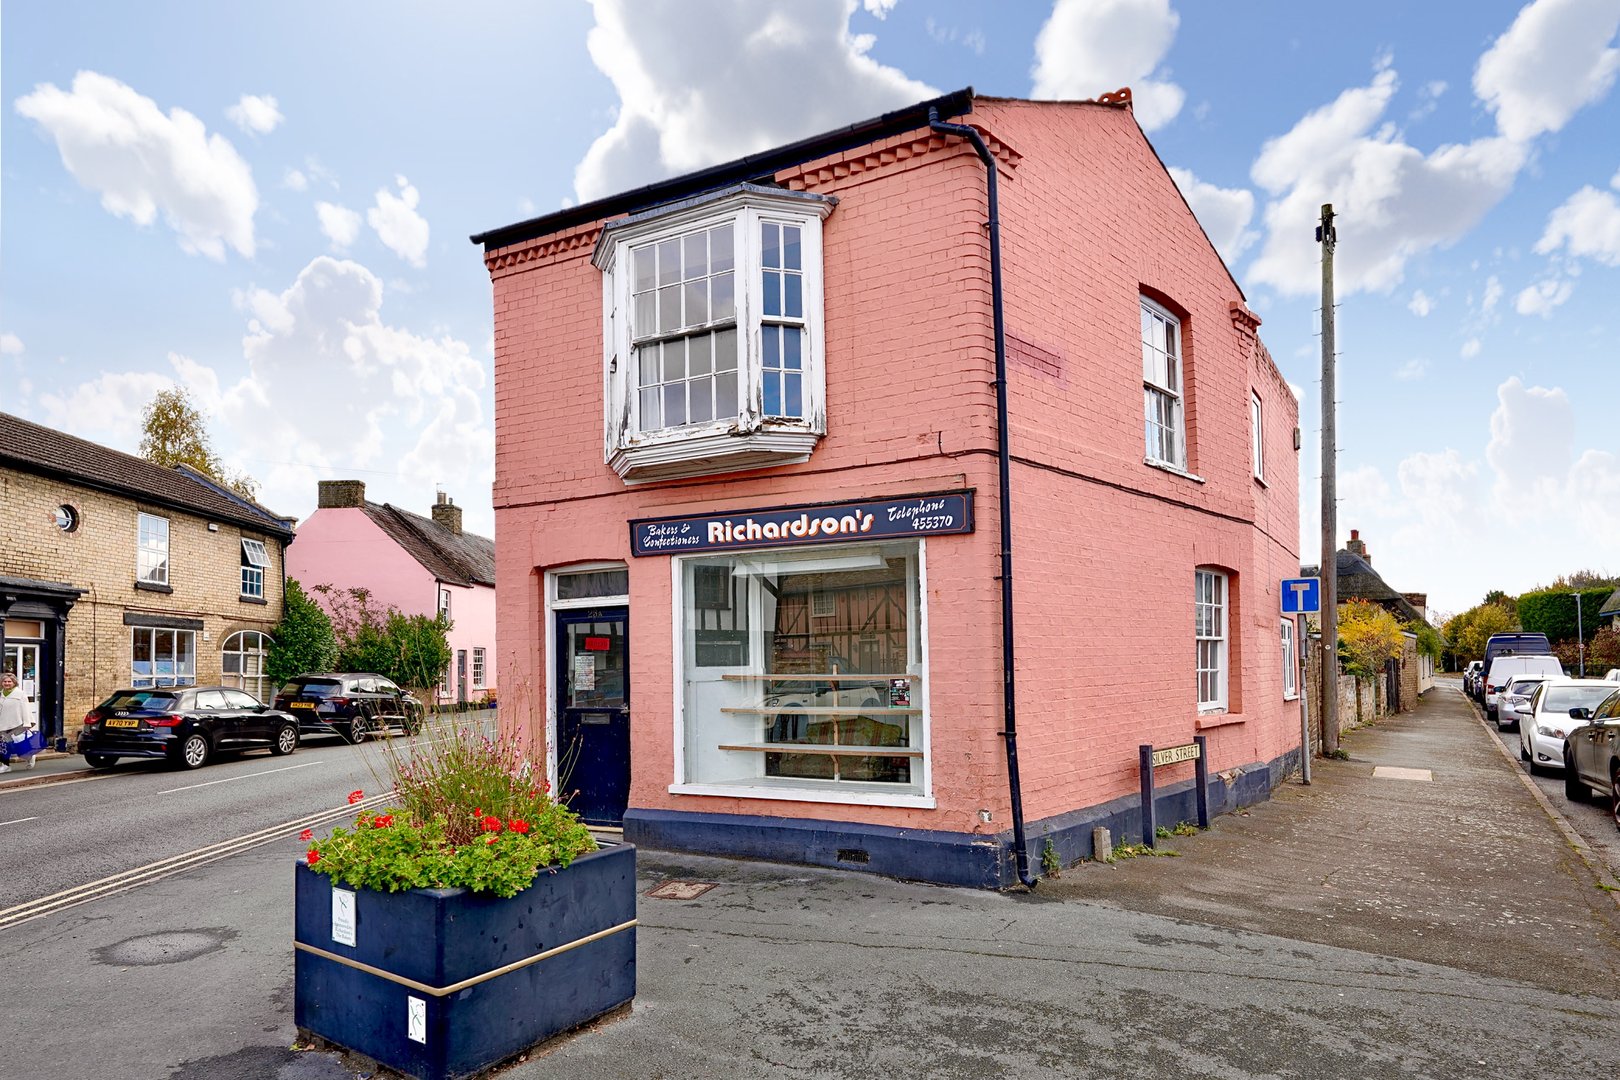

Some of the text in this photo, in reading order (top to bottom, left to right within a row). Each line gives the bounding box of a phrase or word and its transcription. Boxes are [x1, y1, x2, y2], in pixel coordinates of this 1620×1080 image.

[887, 499, 945, 522] Telephone
[647, 523, 691, 536] Bakers &
[707, 509, 874, 544] Richardson's
[912, 515, 953, 530] 455370
[643, 534, 700, 549] Confectioners
[1152, 745, 1198, 765] SILVER STREET
